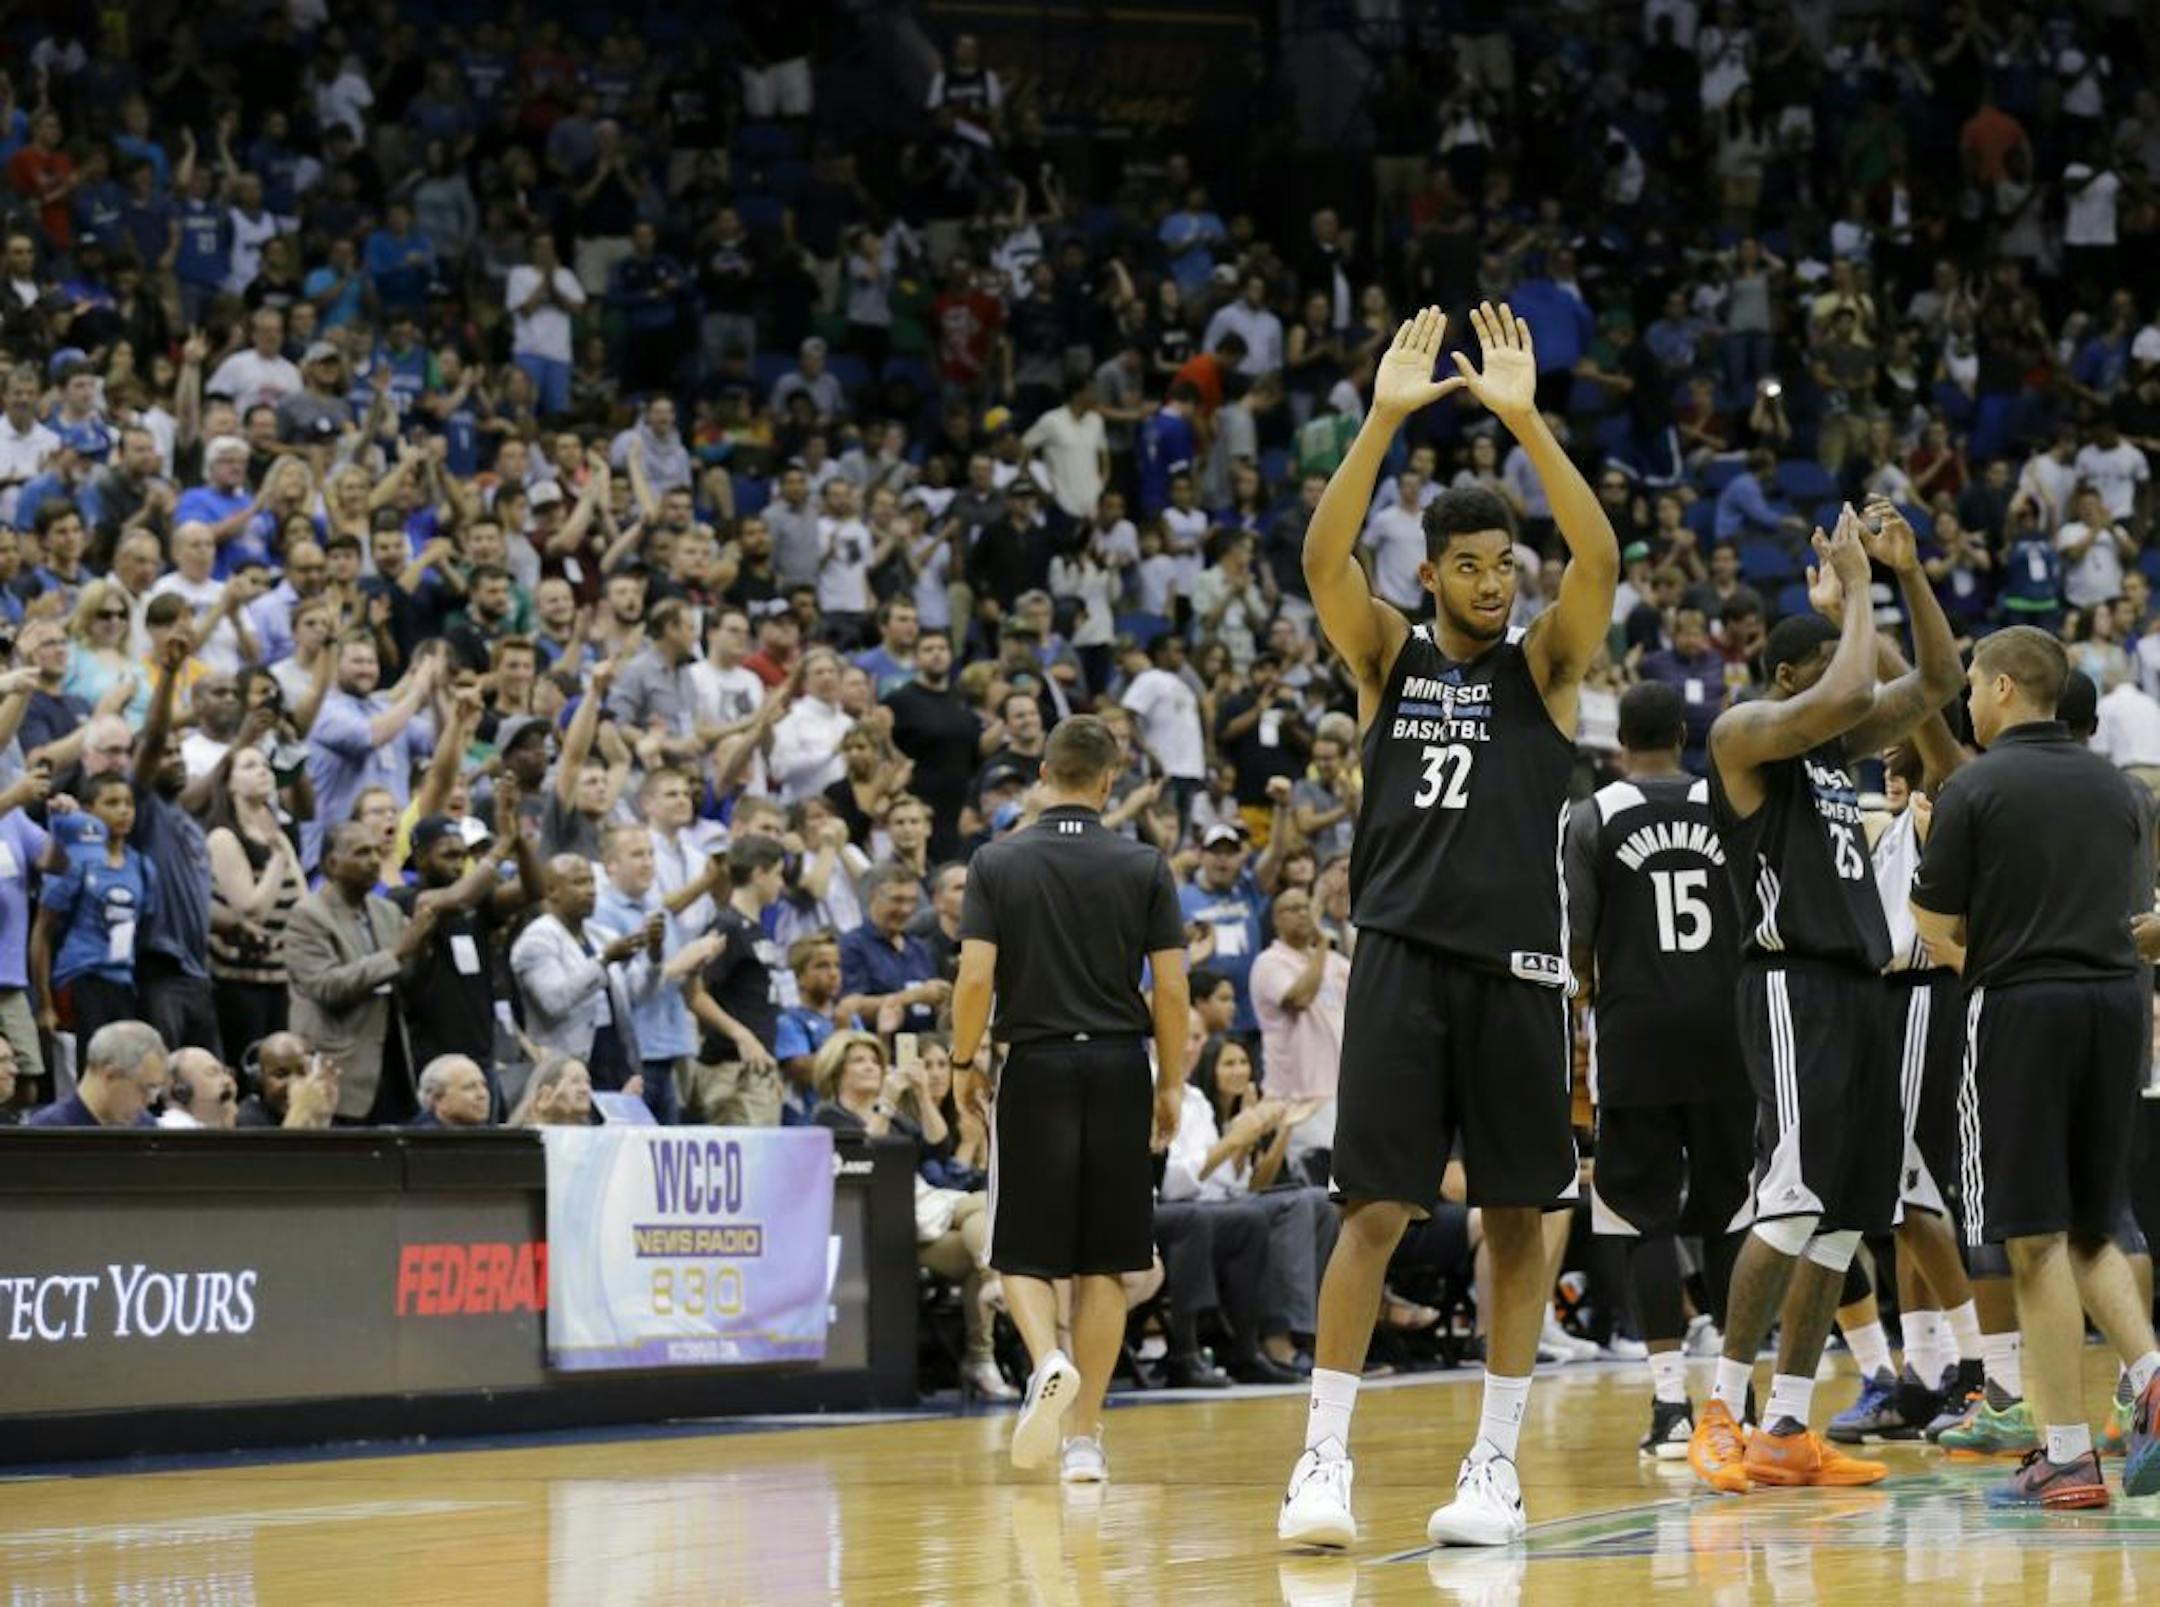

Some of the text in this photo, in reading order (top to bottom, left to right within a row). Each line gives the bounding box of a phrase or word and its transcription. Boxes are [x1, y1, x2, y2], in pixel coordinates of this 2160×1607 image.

[1414, 743, 1473, 809] 32
[1649, 868, 1712, 952] 15
[649, 1140, 742, 1214] WCCO
[651, 1267, 743, 1316] 830
